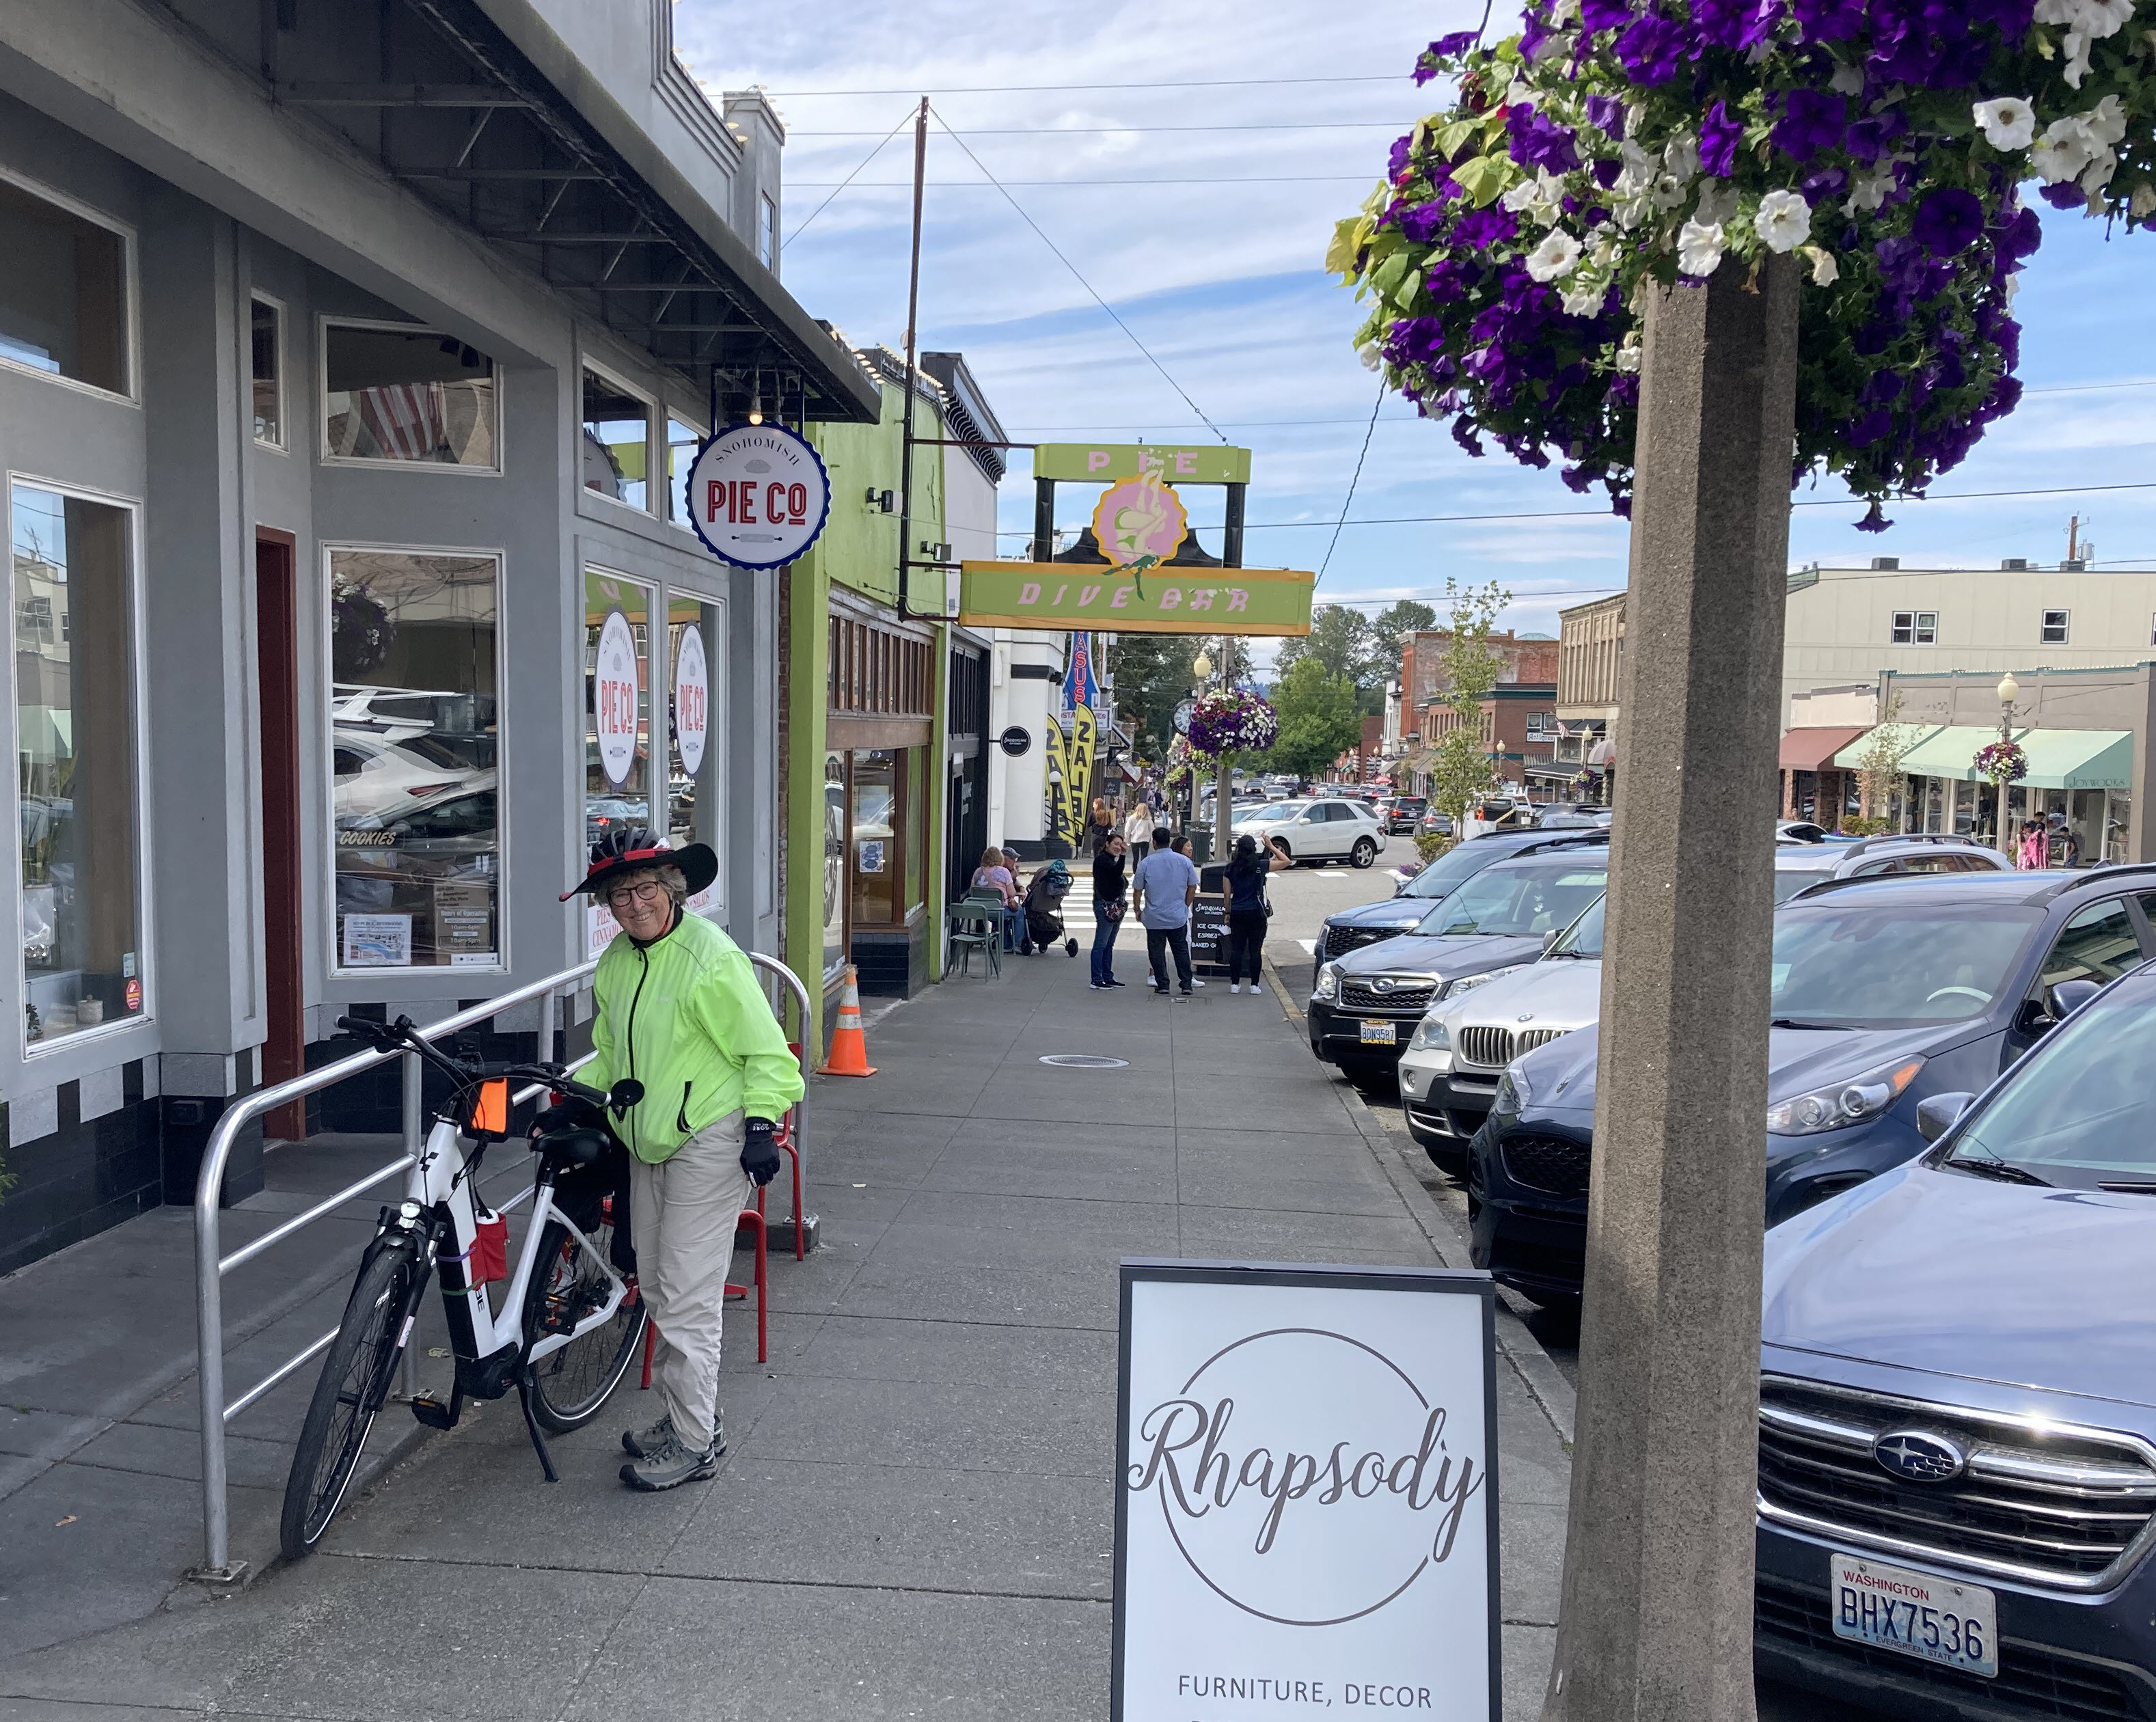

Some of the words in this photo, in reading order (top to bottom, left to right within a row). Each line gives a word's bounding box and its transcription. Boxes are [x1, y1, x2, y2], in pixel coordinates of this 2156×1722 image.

[715, 437, 800, 466] SNOHOMISH
[1088, 451, 1197, 474] PIE
[708, 480, 756, 524] PIE
[1017, 583, 1134, 607] DIVE
[1159, 588, 1250, 612] BAR
[1074, 631, 1087, 702] ASUS
[601, 680, 618, 735] PIE
[680, 684, 693, 731] PIE
[340, 830, 397, 846] COOKIES
[597, 907, 611, 927] PIES
[592, 922, 622, 948] CINNAMO
[1128, 1398, 1485, 1563] Rhapsody
[1843, 1570, 1929, 1601] WASHINGTON
[1841, 1585, 1983, 1660] BHX7536
[1876, 1636, 1924, 1654] EVERGREEN
[1927, 1649, 1953, 1662] STATE
[1179, 1675, 1333, 1708] FURNITURE,
[1345, 1684, 1432, 1709] DECOR
